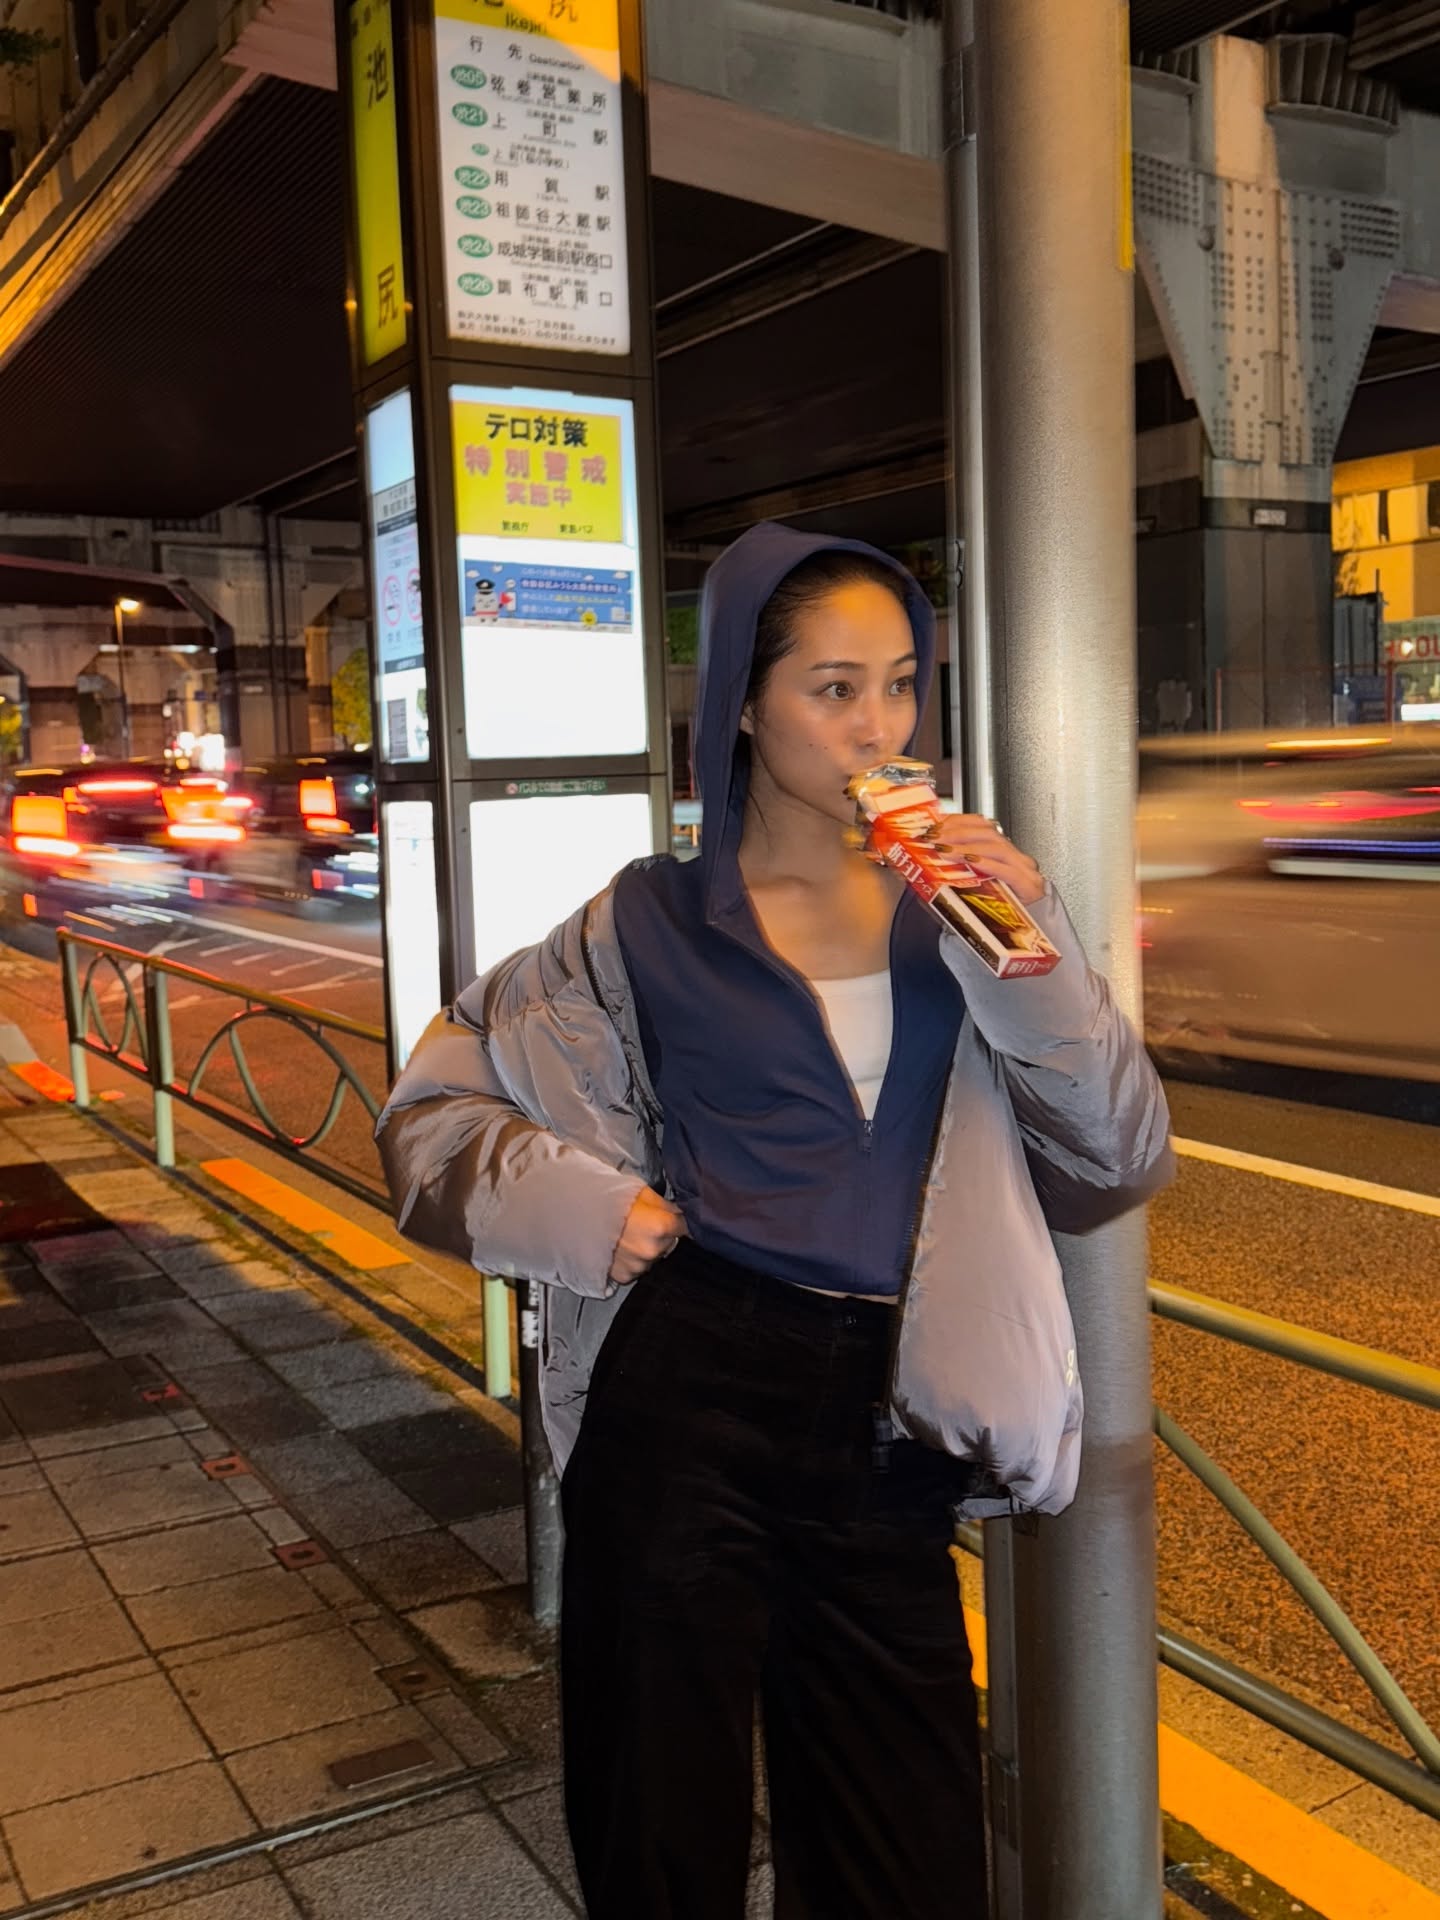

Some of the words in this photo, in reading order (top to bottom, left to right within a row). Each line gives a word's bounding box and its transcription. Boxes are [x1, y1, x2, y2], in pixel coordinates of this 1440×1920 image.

[485, 412, 588, 447] テロ対策
[464, 444, 607, 485] 特別警戒
[505, 481, 572, 508] 実施中
